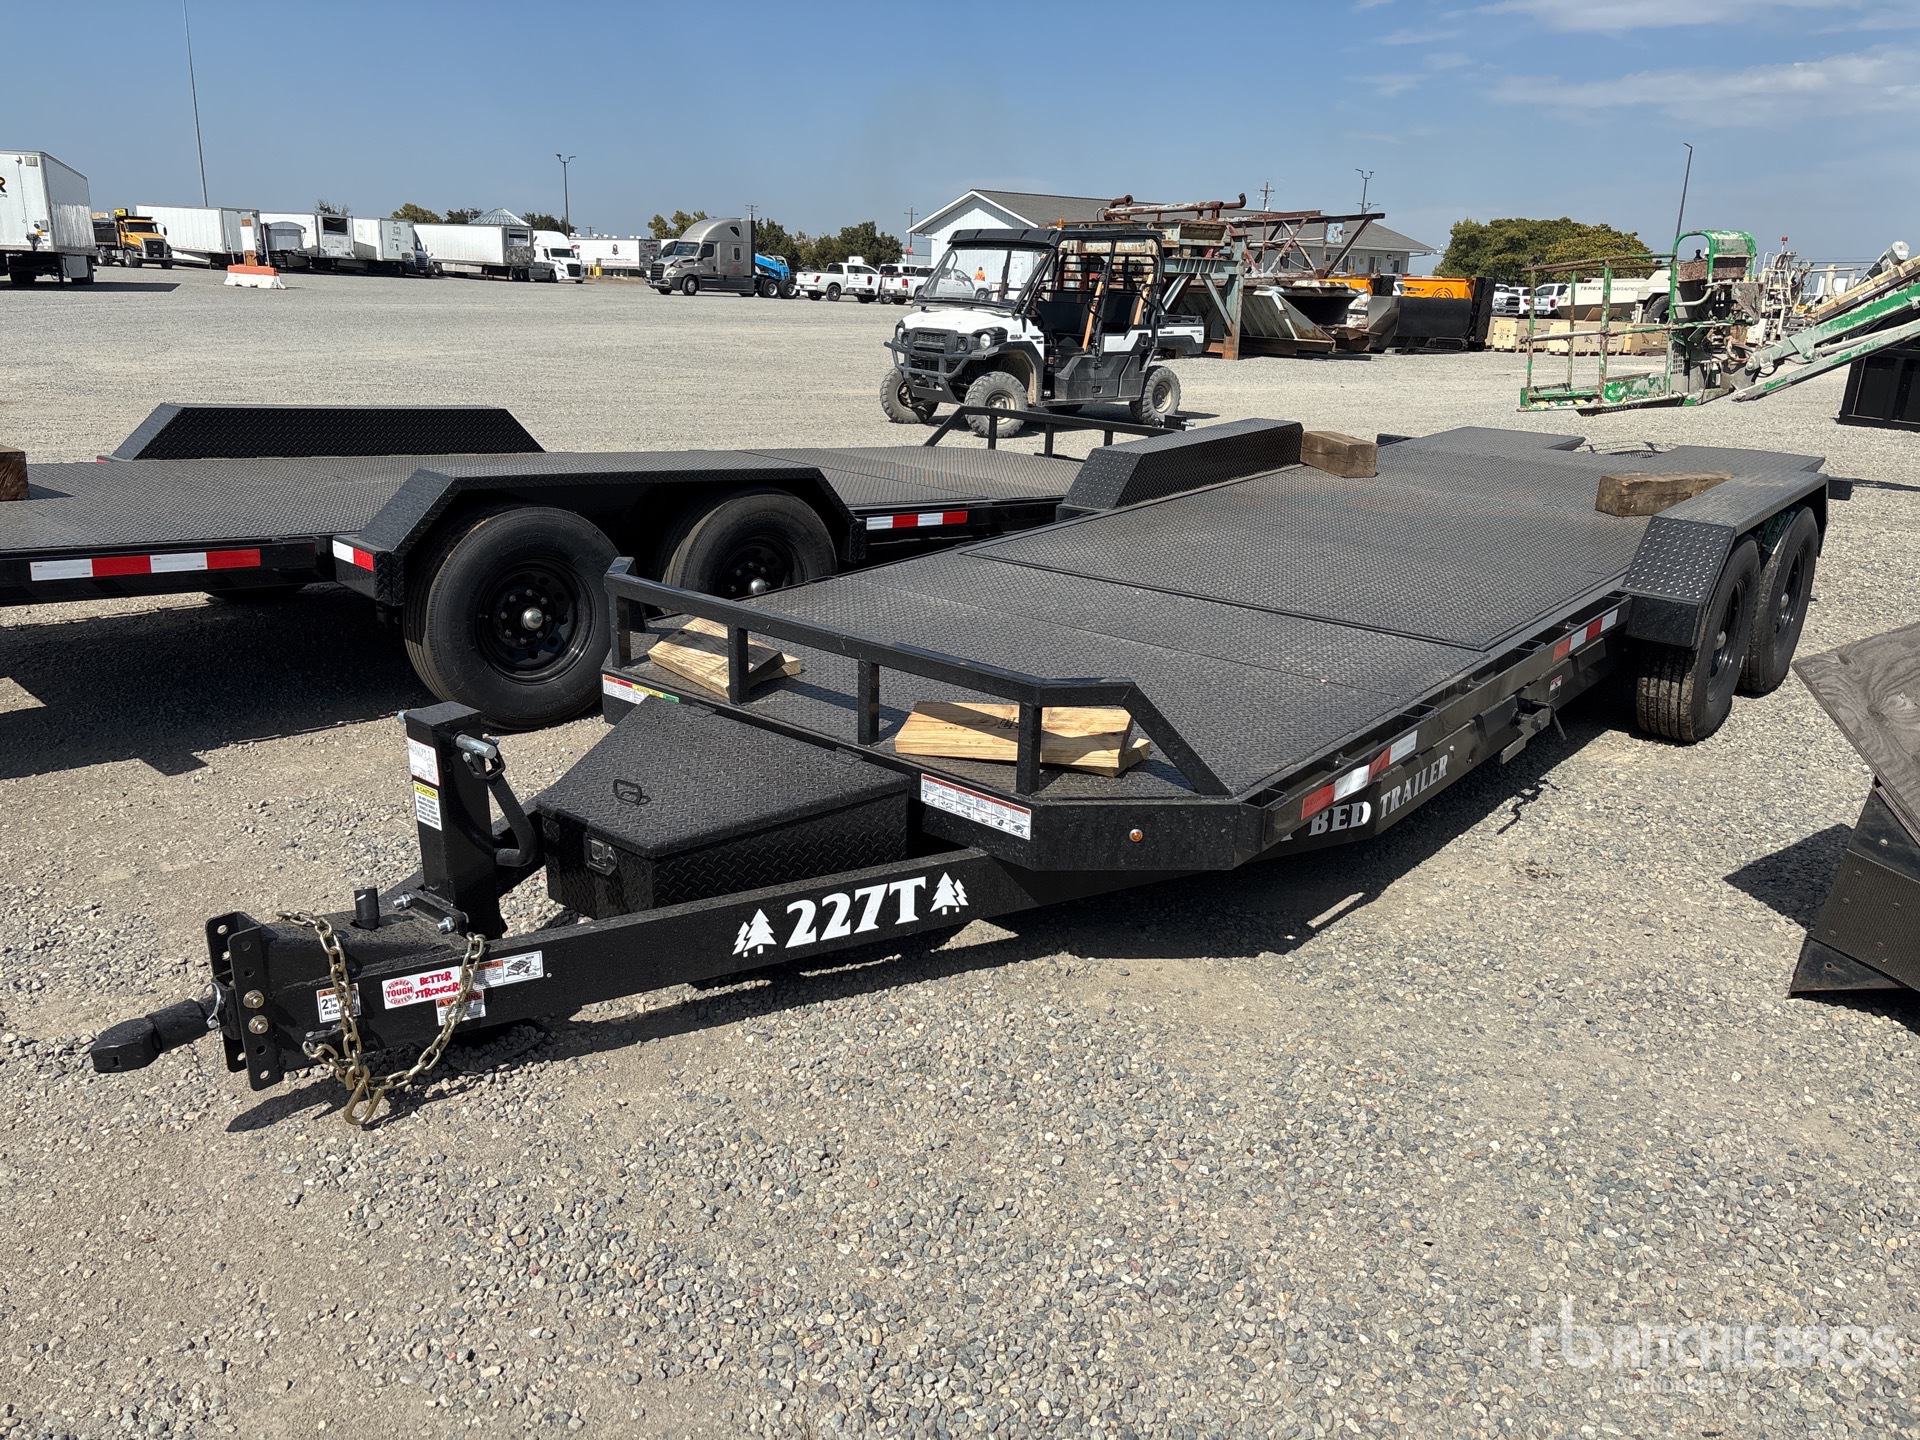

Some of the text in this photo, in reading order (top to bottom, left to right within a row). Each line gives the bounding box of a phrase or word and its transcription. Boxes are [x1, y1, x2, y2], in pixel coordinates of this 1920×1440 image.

[1308, 754, 1449, 837] BED TRAILER
[785, 876, 926, 949] 227T
[419, 971, 453, 986] BETTER
[386, 986, 413, 998] TOUGH
[415, 982, 460, 999] STRONGER
